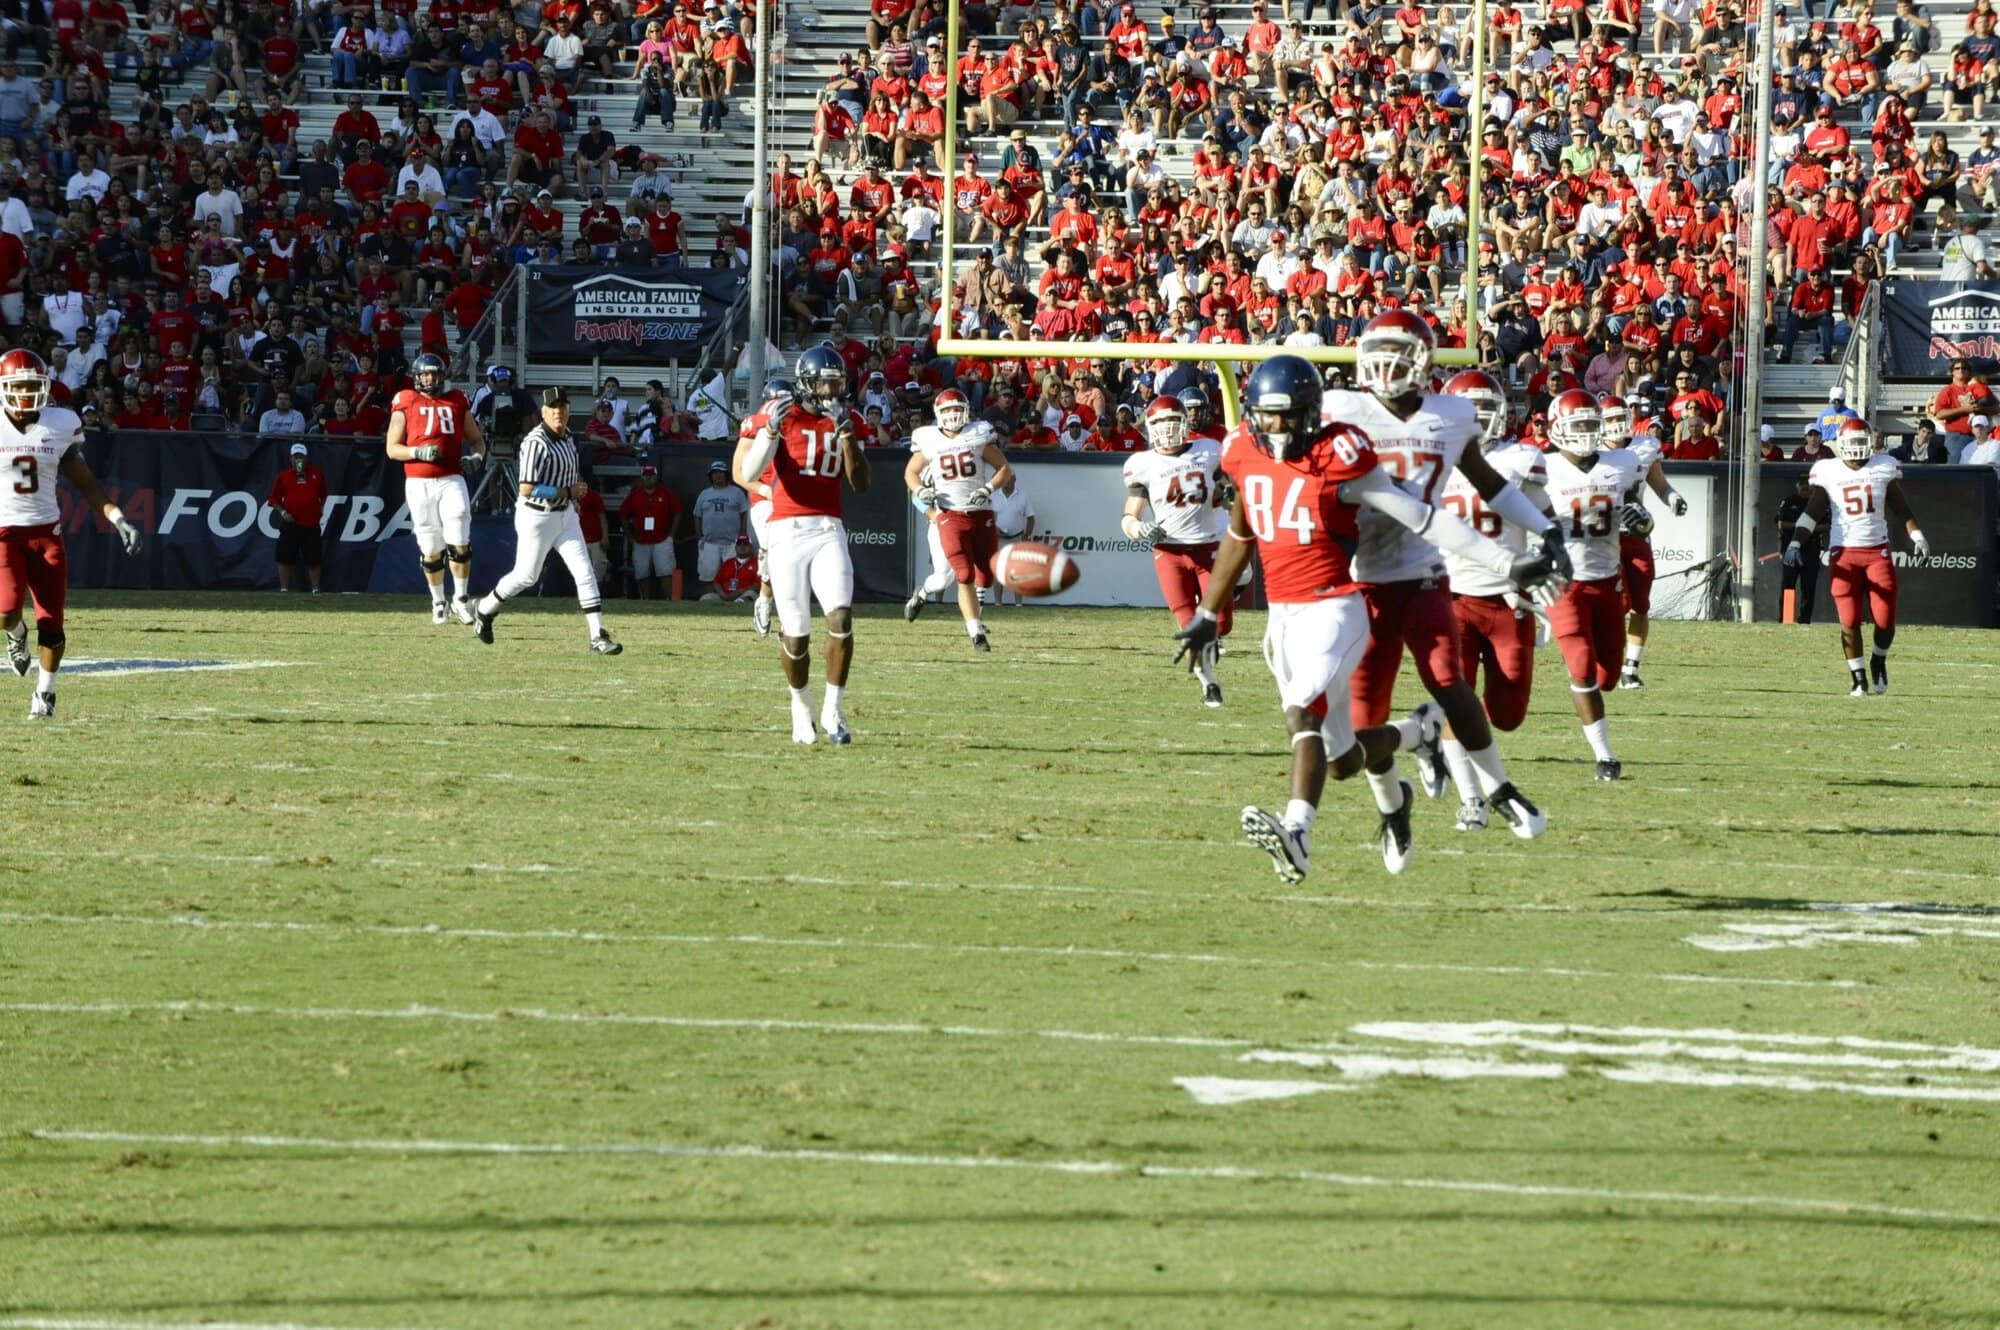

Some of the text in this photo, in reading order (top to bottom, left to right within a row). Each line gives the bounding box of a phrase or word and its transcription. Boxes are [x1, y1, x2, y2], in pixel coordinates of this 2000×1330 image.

[576, 290, 701, 304] AMERICAN FAMILY
[584, 305, 691, 315] INSURANCE
[419, 405, 456, 436] 78
[799, 429, 843, 478] 18
[939, 450, 977, 481] 96
[1332, 428, 1370, 466] 84
[12, 455, 39, 494] 3
[1166, 470, 1209, 507] 43
[157, 487, 414, 542] FOTBA
[1244, 474, 1317, 545] 84
[1570, 494, 1614, 538] 13
[1842, 484, 1876, 516] 51
